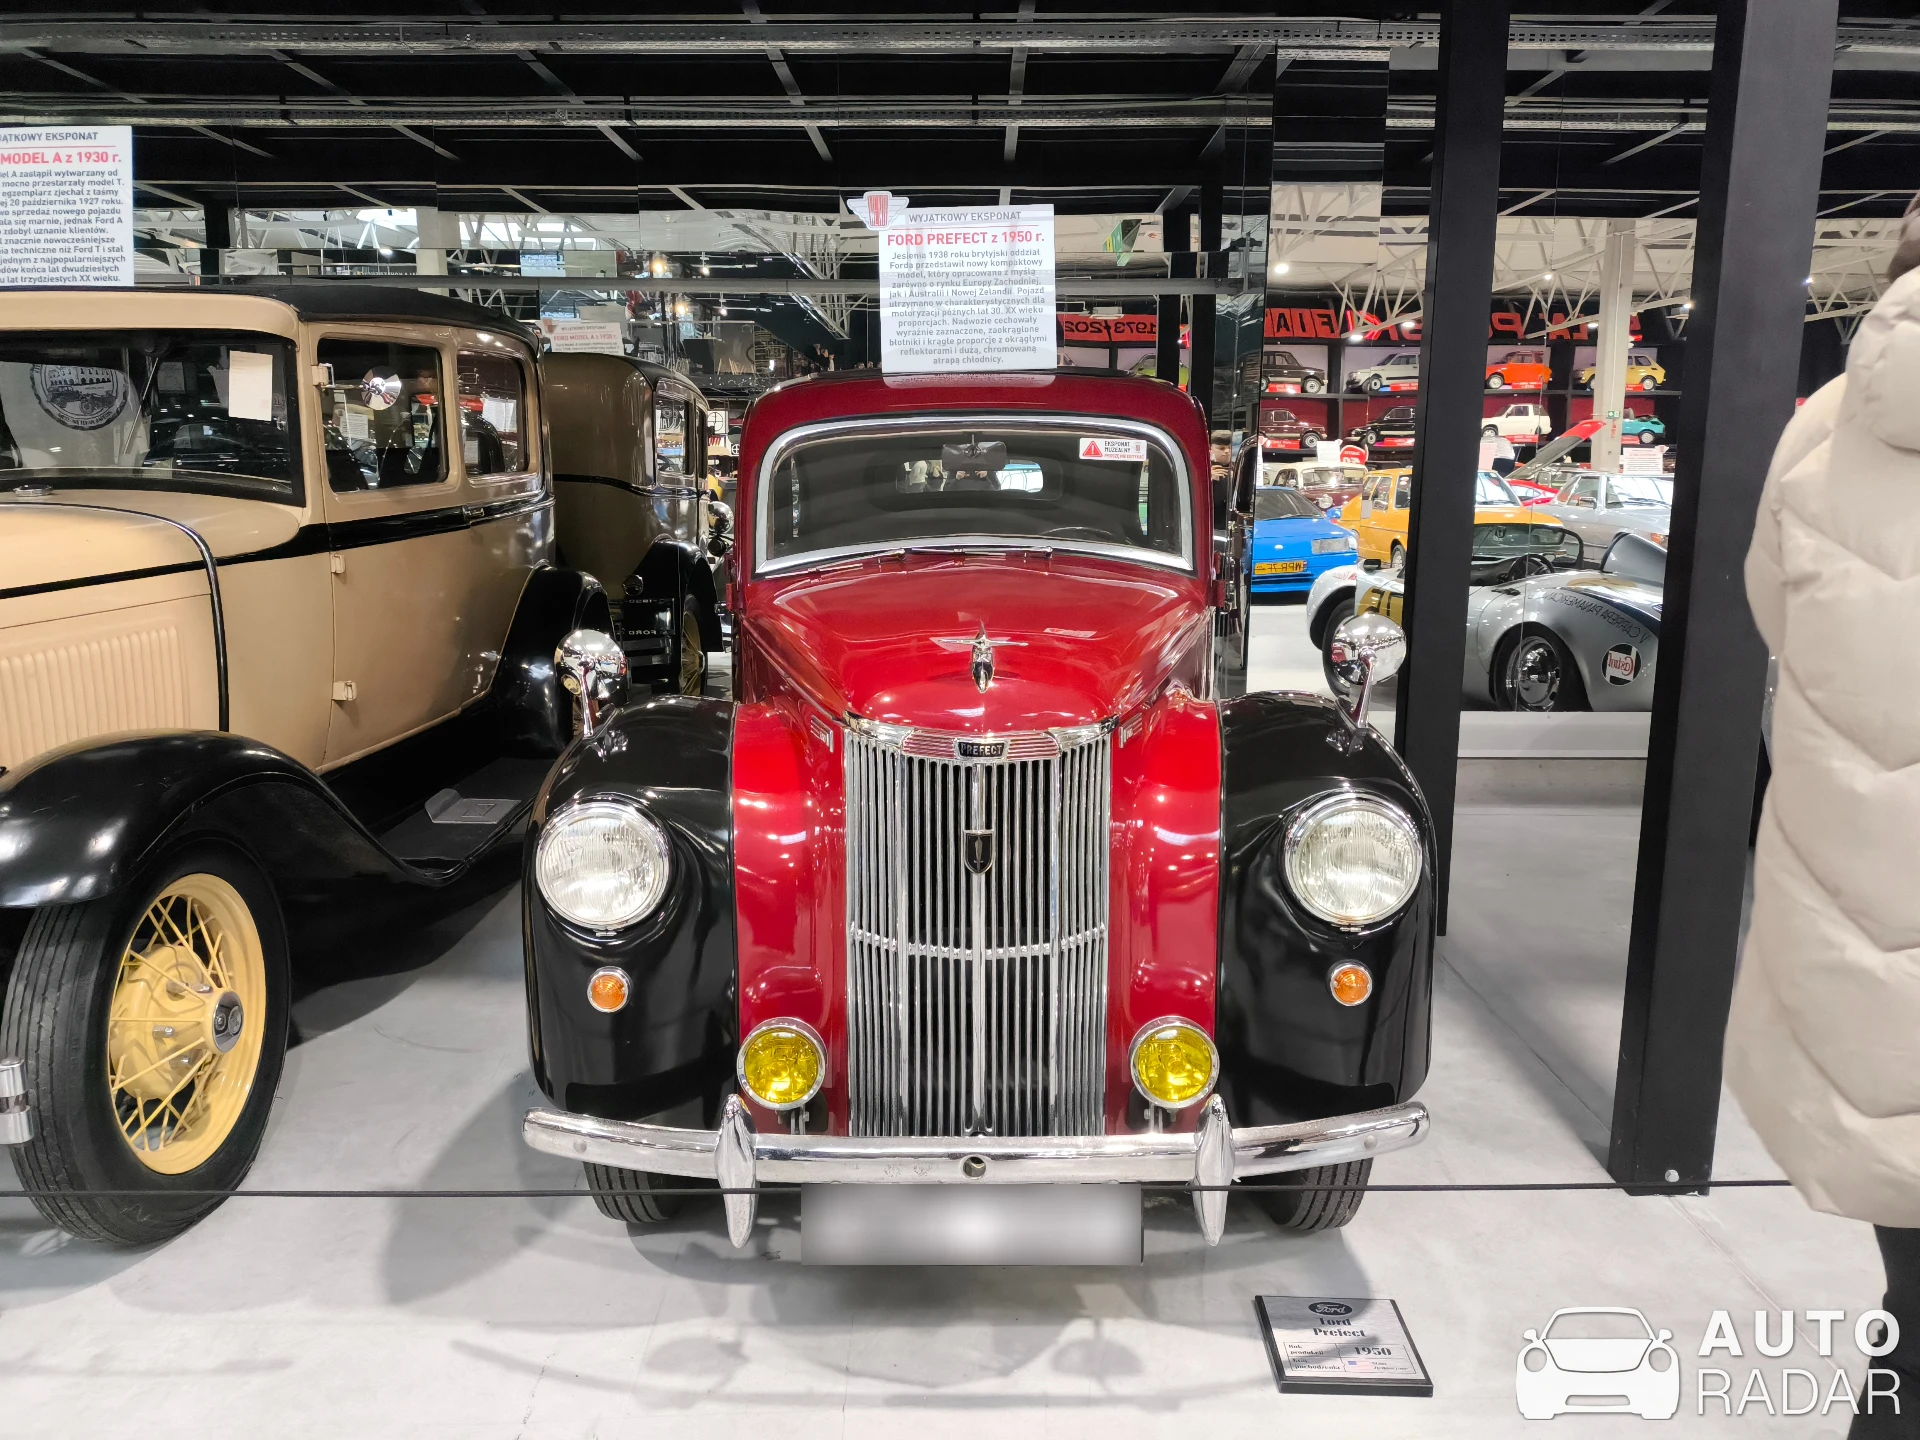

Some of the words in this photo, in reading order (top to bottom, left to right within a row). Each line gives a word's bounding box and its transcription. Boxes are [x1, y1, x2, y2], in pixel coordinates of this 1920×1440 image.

[45, 132, 98, 141] EKSPONAT
[0, 152, 49, 164] MODEL
[52, 152, 62, 163] A
[65, 154, 73, 163] z
[76, 151, 109, 163] 1930
[112, 154, 122, 162] r.
[54, 170, 105, 178] wytwarzany
[107, 169, 118, 177] od
[32, 179, 85, 189] przestarzały
[87, 178, 114, 186] model
[117, 178, 125, 186] T.
[2, 189, 52, 198] egzemplarz
[93, 188, 119, 197] taśmy
[22, 198, 77, 208] października
[101, 197, 124, 205] roku.
[12, 208, 50, 217] sprzedaż
[52, 209, 86, 217] nowego
[87, 207, 121, 216] pojazdu
[14, 218, 27, 227] się
[28, 217, 62, 226] marnie,
[63, 217, 93, 226] jednak
[95, 216, 115, 224] Ford
[116, 216, 123, 224] A
[909, 213, 968, 224] WYJĄTKOWY
[971, 211, 1021, 221] EKSPONAT
[33, 227, 67, 235] uznanie
[69, 226, 109, 234] klientów.
[4, 236, 41, 245] znacznie
[43, 236, 115, 245] nowocześniejsze
[887, 233, 923, 246] FORD
[927, 232, 988, 245] PREFECT
[991, 234, 998, 243] z
[1002, 230, 1032, 243] 1950
[1036, 233, 1045, 242] r.
[11, 246, 56, 254] techniczne
[929, 251, 948, 259] 1938
[950, 250, 970, 258] roku
[972, 249, 1008, 259] brytyjski
[0, 257, 31, 265] jednym
[40, 255, 126, 265] najpopularniejszych
[990, 258, 1043, 268] kompaktowy
[48, 265, 60, 273] lat
[61, 265, 120, 273] dwudziestych
[20, 275, 77, 284] trzydziestych
[92, 274, 121, 282] wieku.
[897, 271, 926, 279] model,
[928, 270, 950, 279] który
[952, 270, 1002, 279] opracowano
[936, 279, 961, 288] rynku
[963, 278, 992, 287] Europy
[889, 291, 902, 300] jak
[909, 289, 945, 297] Australii
[951, 289, 977, 298] Nowej
[1017, 286, 1045, 296] Pojazd
[889, 300, 934, 309] utrzymano
[944, 297, 1030, 307] charakterystycznych
[1032, 296, 1045, 304] dla
[892, 309, 940, 318] motoryzacji
[942, 308, 976, 317] późnych
[977, 307, 989, 315] lat
[991, 307, 1003, 315] 30.
[1005, 306, 1017, 314] XX
[1018, 306, 1044, 314] wieku
[898, 318, 950, 328] proporcjach.
[952, 317, 992, 325] Nadwozie
[994, 316, 1038, 325] cechowały
[896, 328, 934, 337] wyraźnie
[935, 328, 986, 336] zaznaczone,
[988, 326, 1040, 335] zaokrąglone
[889, 338, 921, 346] błotniki
[956, 336, 997, 345] proporcje
[900, 347, 953, 356] reflektorami
[962, 355, 1004, 364] chłodnicy.
[961, 743, 1002, 755] PREFECT
[1315, 1304, 1346, 1313] Ford
[1354, 1346, 1392, 1356] 1950
